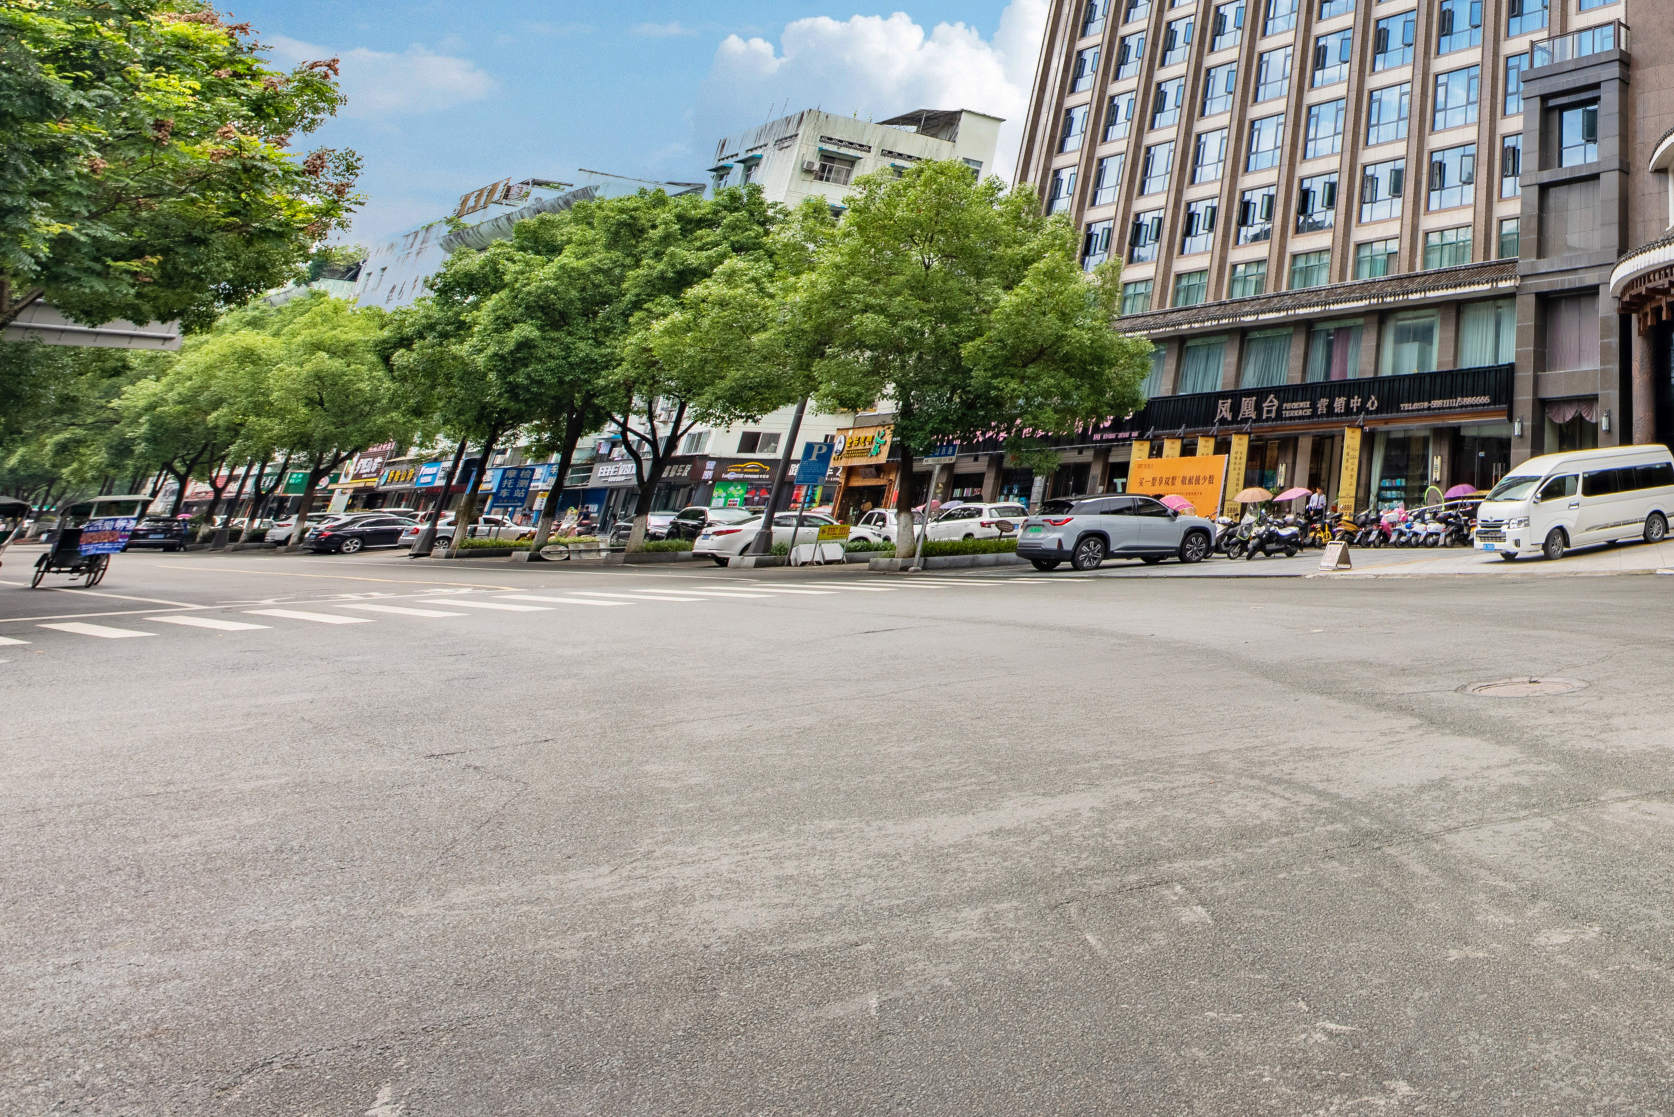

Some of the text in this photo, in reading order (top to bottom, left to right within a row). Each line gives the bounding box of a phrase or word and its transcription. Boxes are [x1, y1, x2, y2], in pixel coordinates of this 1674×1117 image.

[1213, 393, 1279, 423] 凤凰台
[1282, 400, 1311, 410] PHOENIX
[1282, 408, 1313, 418] TERRACE
[1316, 394, 1379, 415] 营销中心
[808, 444, 828, 461] P
